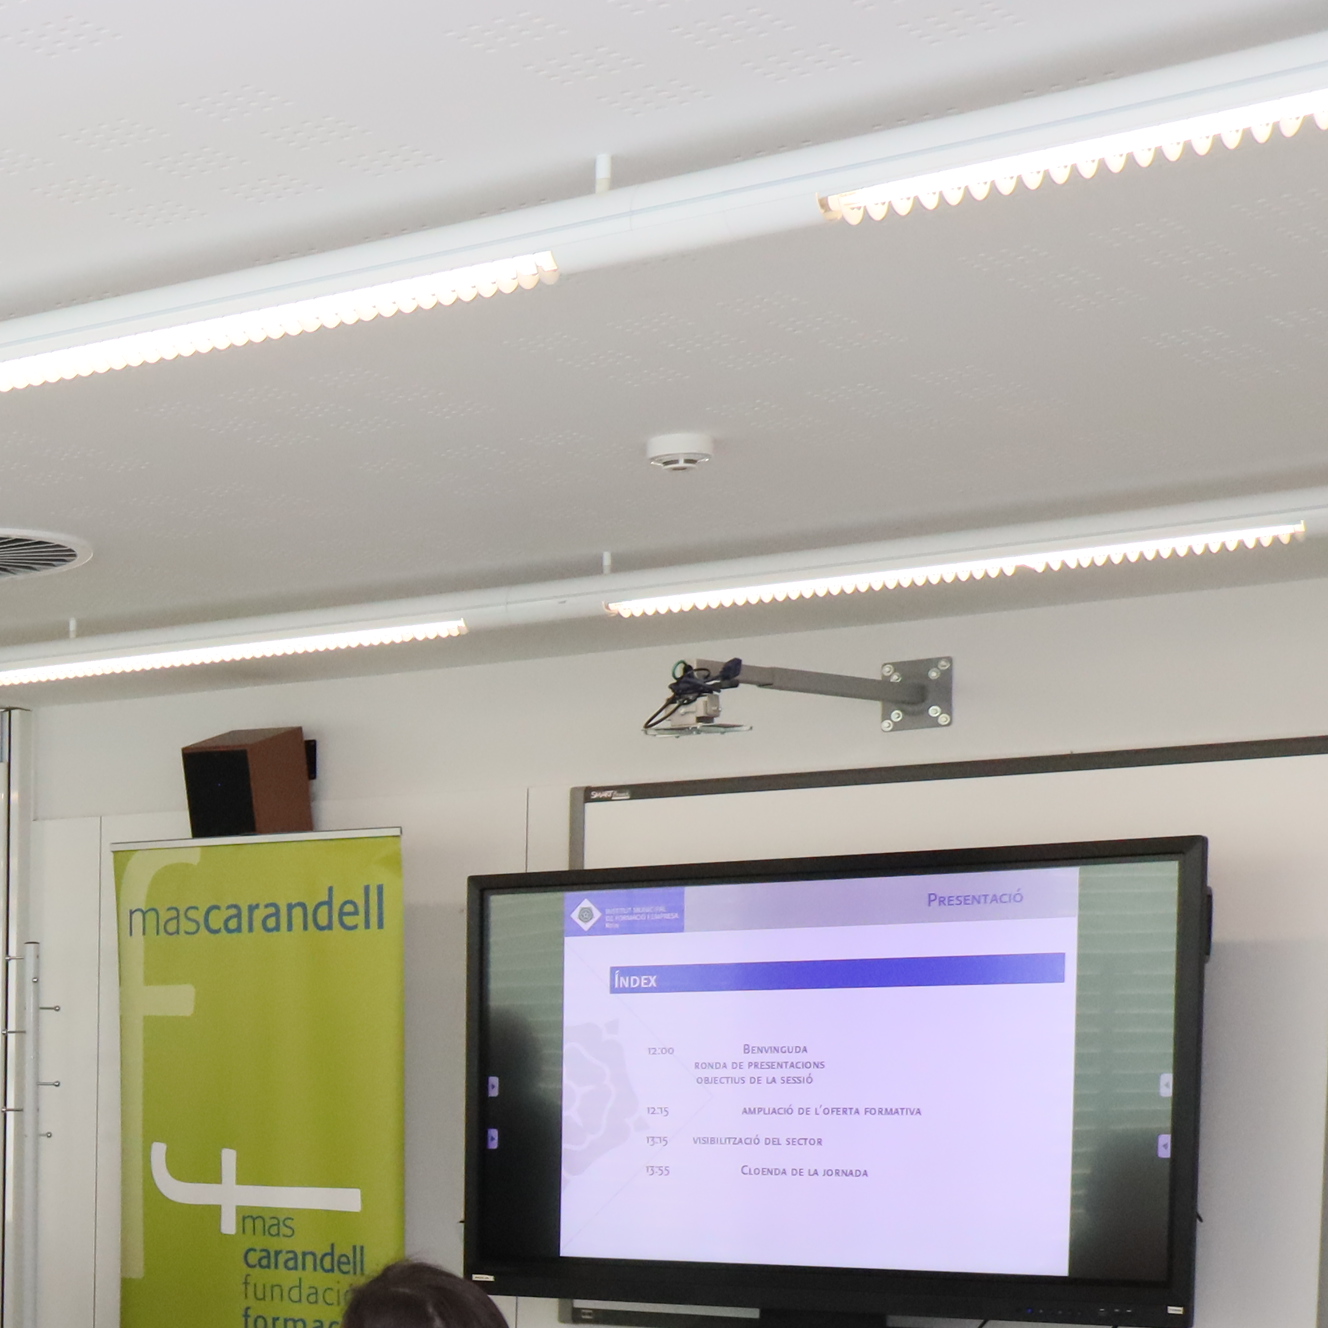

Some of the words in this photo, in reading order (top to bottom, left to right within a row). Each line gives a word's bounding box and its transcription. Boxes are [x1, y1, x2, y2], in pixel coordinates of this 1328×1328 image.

[927, 888, 1024, 907] PRESENTACIÓ
[128, 883, 385, 938] mascarandell
[614, 970, 658, 988] ÍNDEX
[743, 1043, 808, 1055] BENVINGUDA
[694, 1062, 728, 1070] RONDA
[731, 1062, 744, 1070] DE
[747, 1061, 826, 1070] PRESENTACIONS
[696, 1076, 746, 1085] OBJECTIUS
[749, 1076, 762, 1085] DE
[765, 1076, 777, 1085] LA
[780, 1073, 814, 1085] SESSIÓ
[741, 1103, 794, 1116] AMPLIACIÓ
[797, 1107, 811, 1116] DE
[864, 1107, 922, 1117] FORMATIVA
[692, 1134, 761, 1146] VISIBILITZACIÓ
[764, 1137, 782, 1146] DEL
[785, 1137, 823, 1147] SECTOR
[740, 1164, 787, 1176] CLOENDA
[791, 1167, 804, 1177] DE
[807, 1168, 820, 1177] LA
[822, 1168, 869, 1178] JORNADA
[241, 1214, 295, 1238] mas
[243, 1243, 366, 1276] carandell
